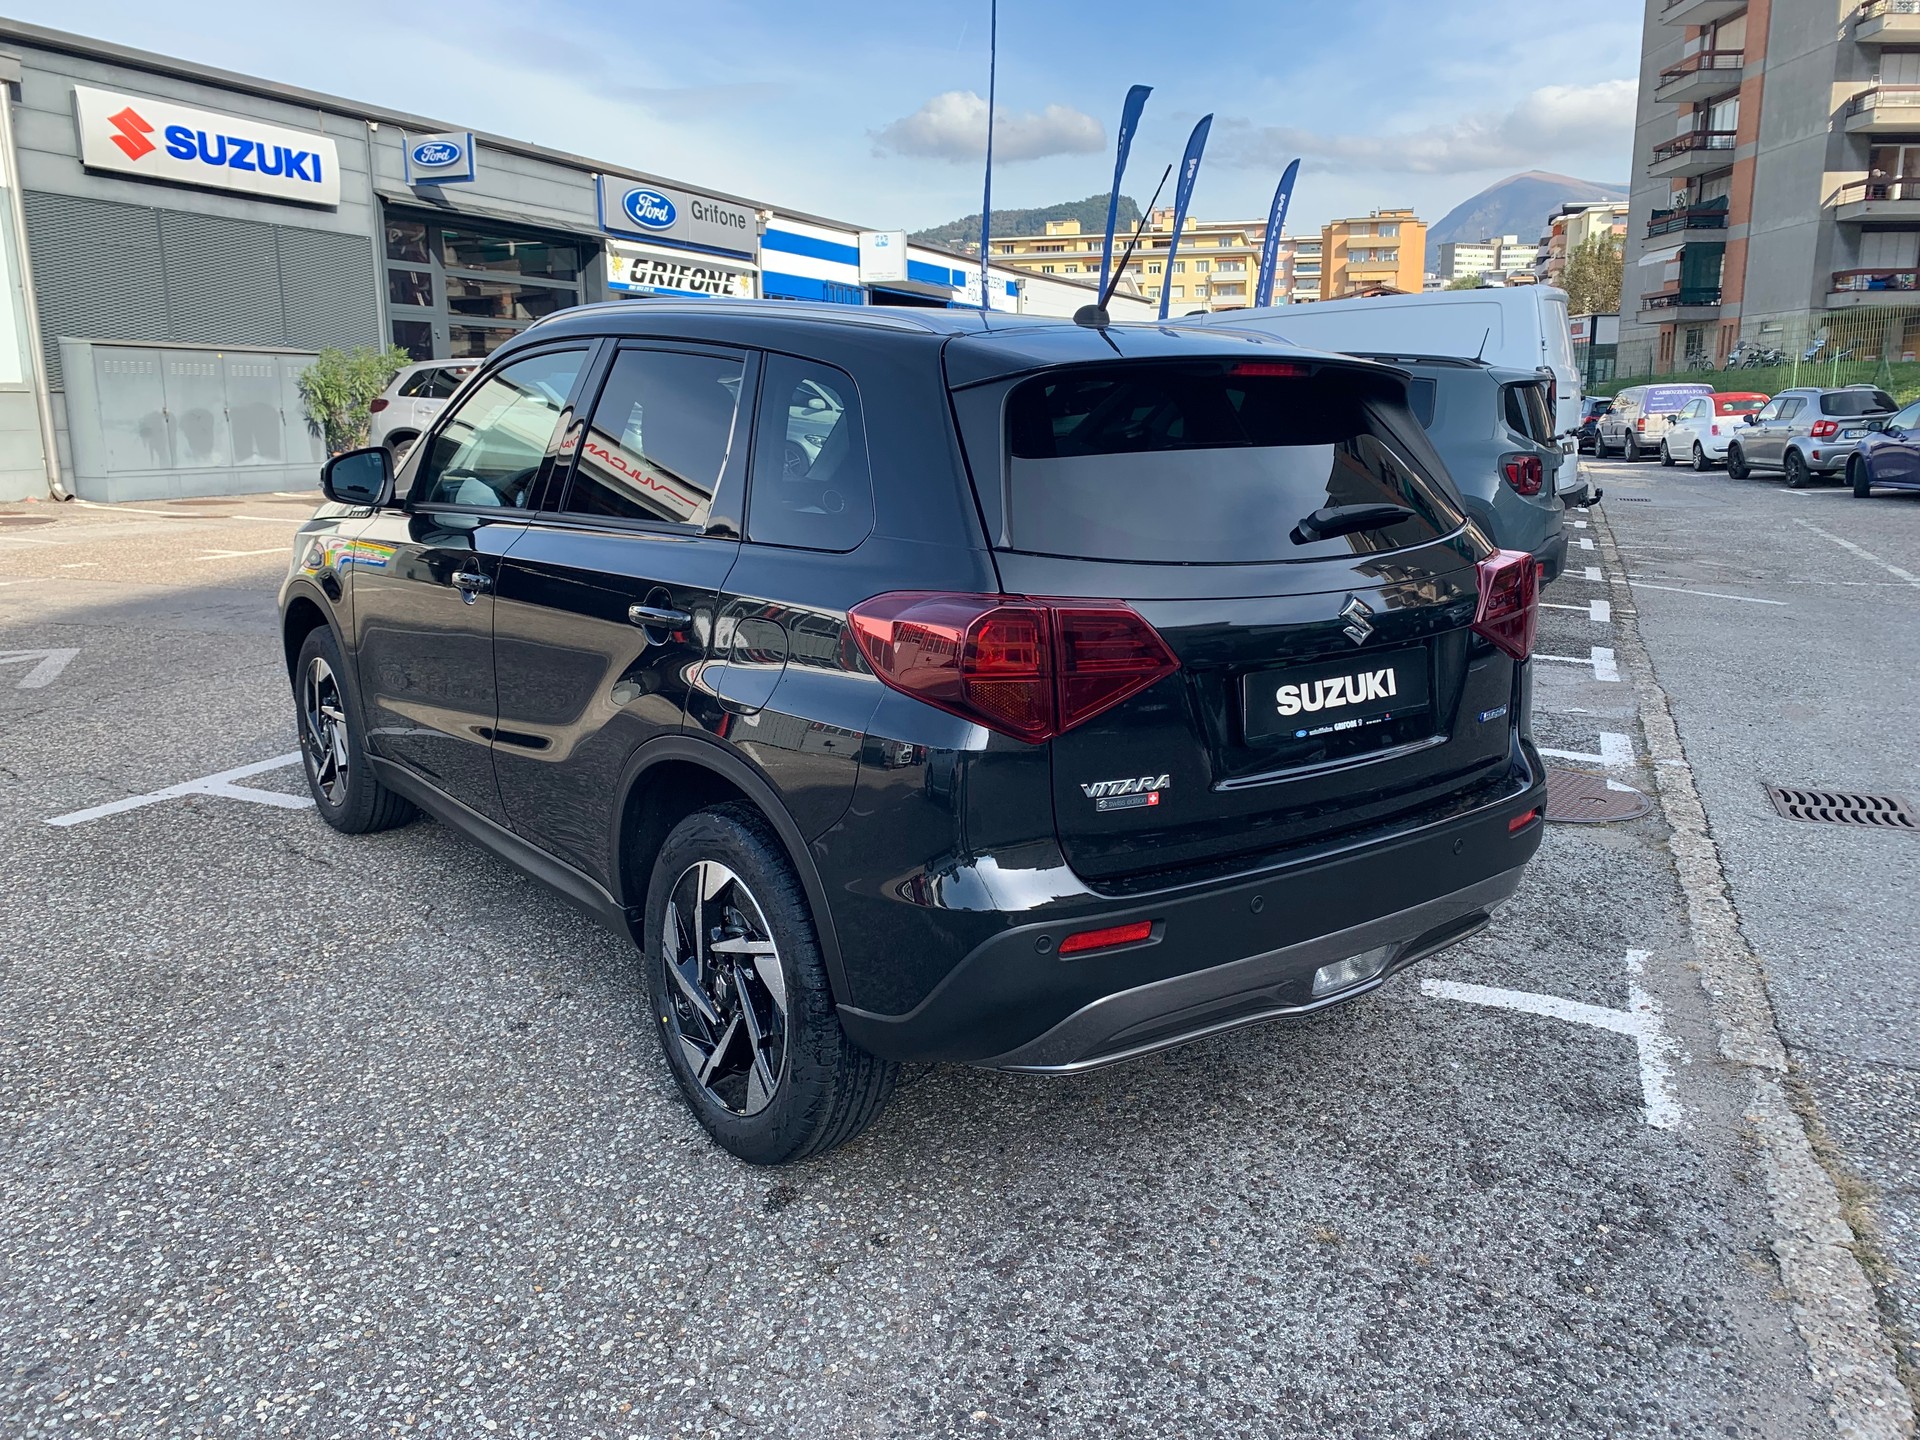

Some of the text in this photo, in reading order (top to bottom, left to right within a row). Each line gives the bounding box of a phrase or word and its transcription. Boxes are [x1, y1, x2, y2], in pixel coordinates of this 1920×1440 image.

[164, 125, 322, 183] SUZUKI
[421, 145, 451, 162] Ford
[635, 193, 669, 222] Ford
[691, 200, 747, 229] Grifone
[1263, 193, 1287, 281] CUSTOM
[629, 258, 737, 295] GRIFONE
[1275, 668, 1397, 716] SUZUKI
[1080, 774, 1170, 798] VITARA
[1108, 796, 1147, 808] swiss edition
